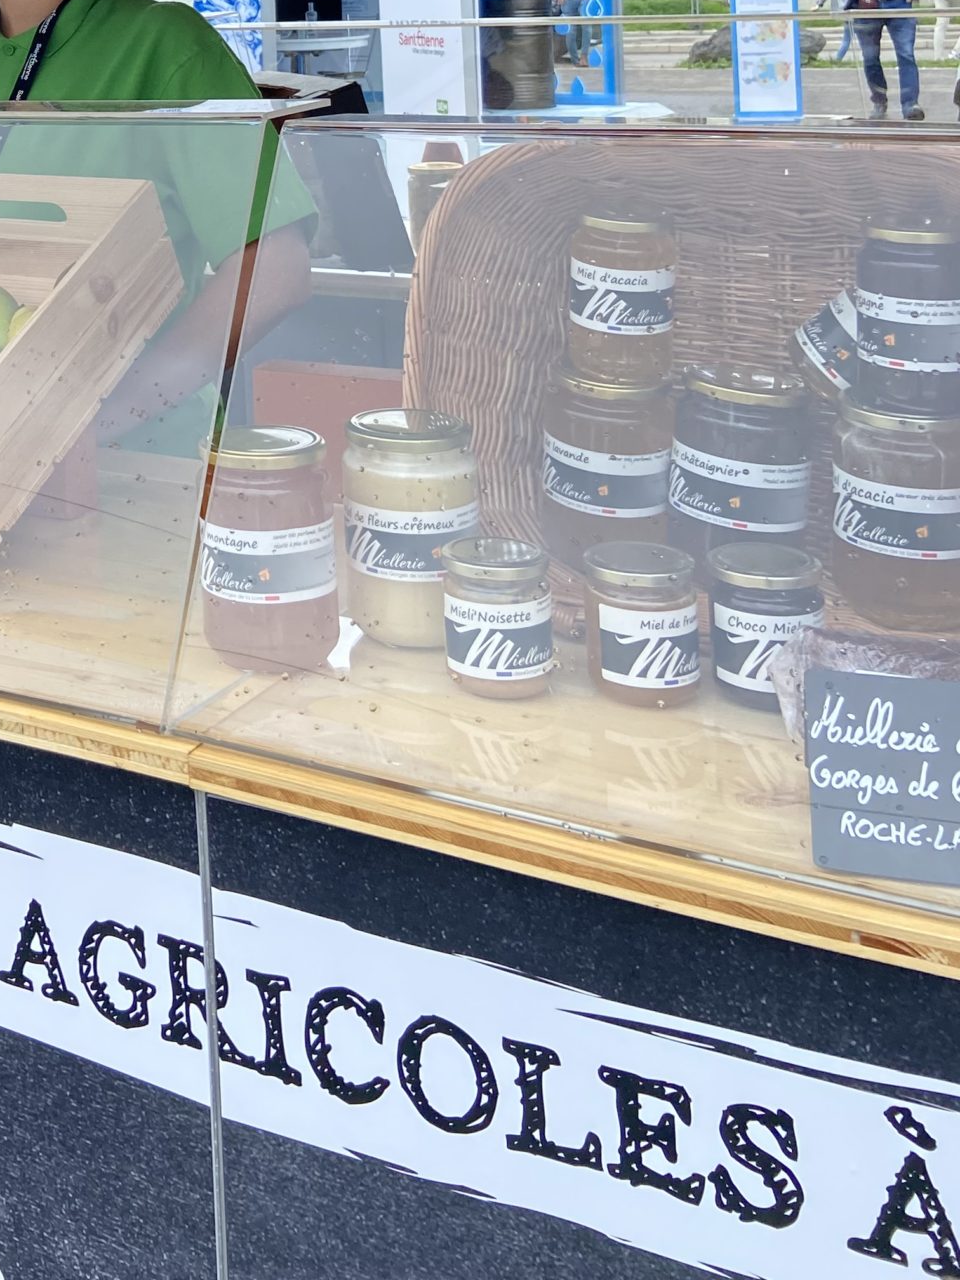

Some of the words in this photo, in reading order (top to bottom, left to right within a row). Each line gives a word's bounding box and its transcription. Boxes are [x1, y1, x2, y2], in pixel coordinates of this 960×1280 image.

[577, 266, 596, 281] Miel
[600, 272, 648, 286] d'acacia
[576, 282, 664, 326] Miellerie
[552, 442, 590, 464] lavande
[680, 450, 742, 477] châtaignier
[841, 479, 895, 505] d'acacia
[367, 513, 398, 530] fleurs
[403, 519, 454, 531] crémeux
[206, 532, 258, 552] montagne
[345, 522, 426, 569] Miellerie
[640, 619, 665, 630] Miel
[668, 618, 680, 629] de
[727, 615, 767, 633] Choco
[772, 620, 801, 634] Miel
[810, 693, 940, 753] Miellerie
[907, 760, 939, 800] de
[846, 1105, 960, 1280] À
